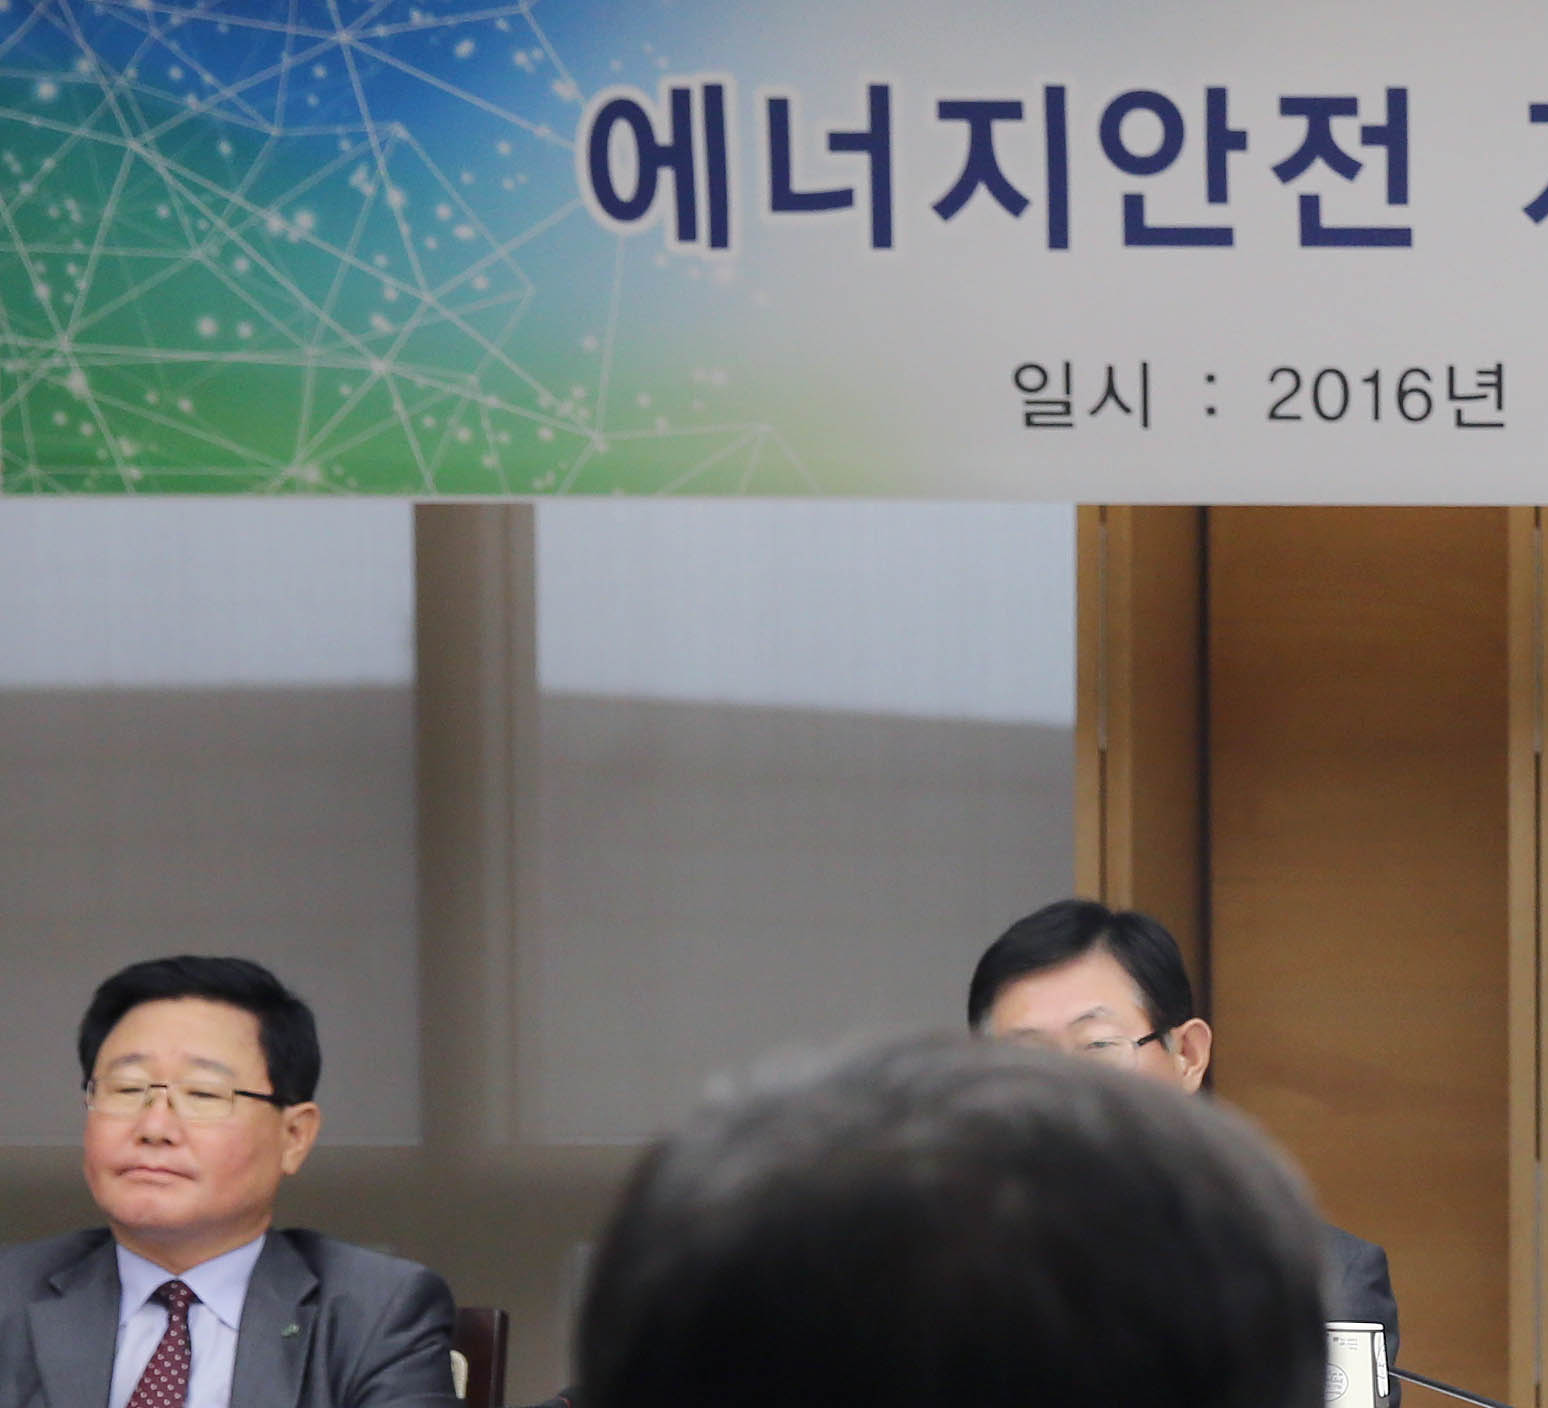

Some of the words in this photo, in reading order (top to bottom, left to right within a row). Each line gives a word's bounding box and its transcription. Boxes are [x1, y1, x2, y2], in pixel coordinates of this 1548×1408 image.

[587, 83, 1412, 251] 에너지안전
[1012, 361, 1150, 430] 일시
[1267, 362, 1505, 429] 2016년
